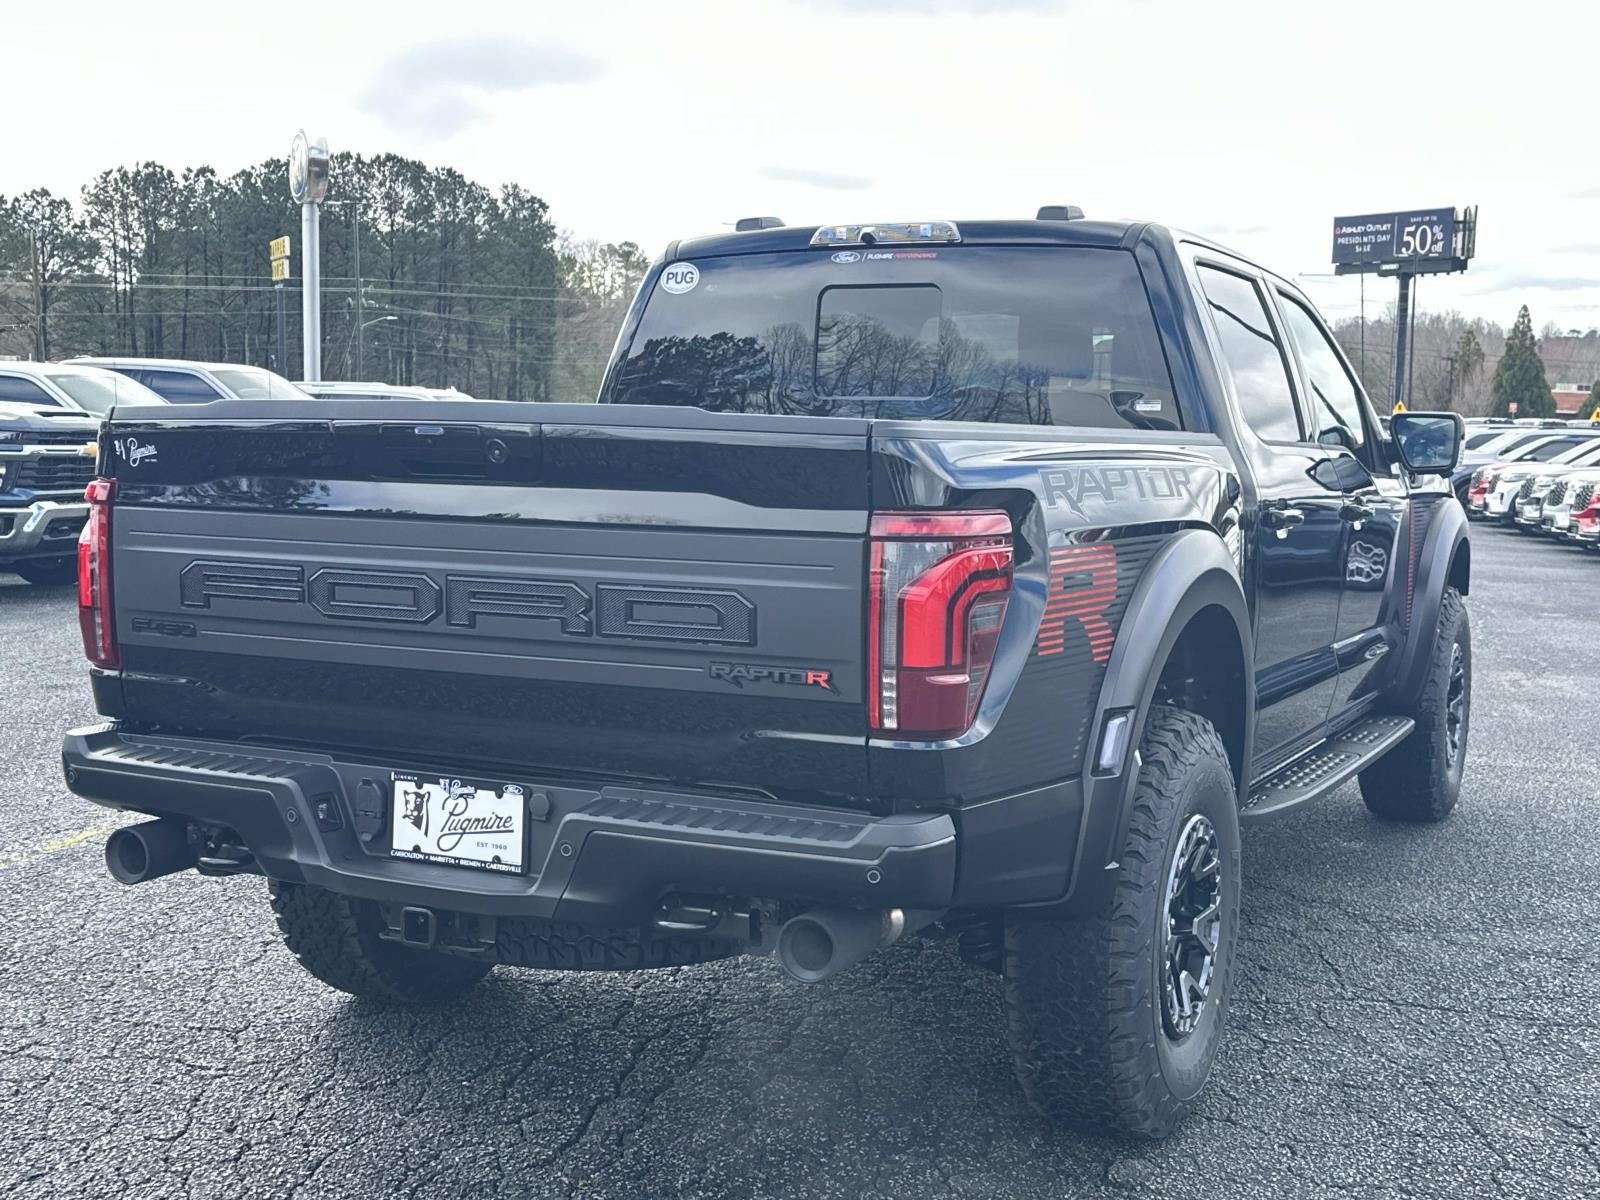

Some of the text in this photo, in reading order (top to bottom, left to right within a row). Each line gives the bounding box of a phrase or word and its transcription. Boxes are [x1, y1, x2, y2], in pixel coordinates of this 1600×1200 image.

[1366, 223, 1391, 232] OUTLET
[1376, 234, 1391, 243] DAY
[666, 271, 695, 285] PUG
[1037, 467, 1200, 523] RAPTOR
[180, 559, 757, 647] FORD
[709, 661, 840, 696] RAPTOR
[437, 795, 514, 852] Pugmire
